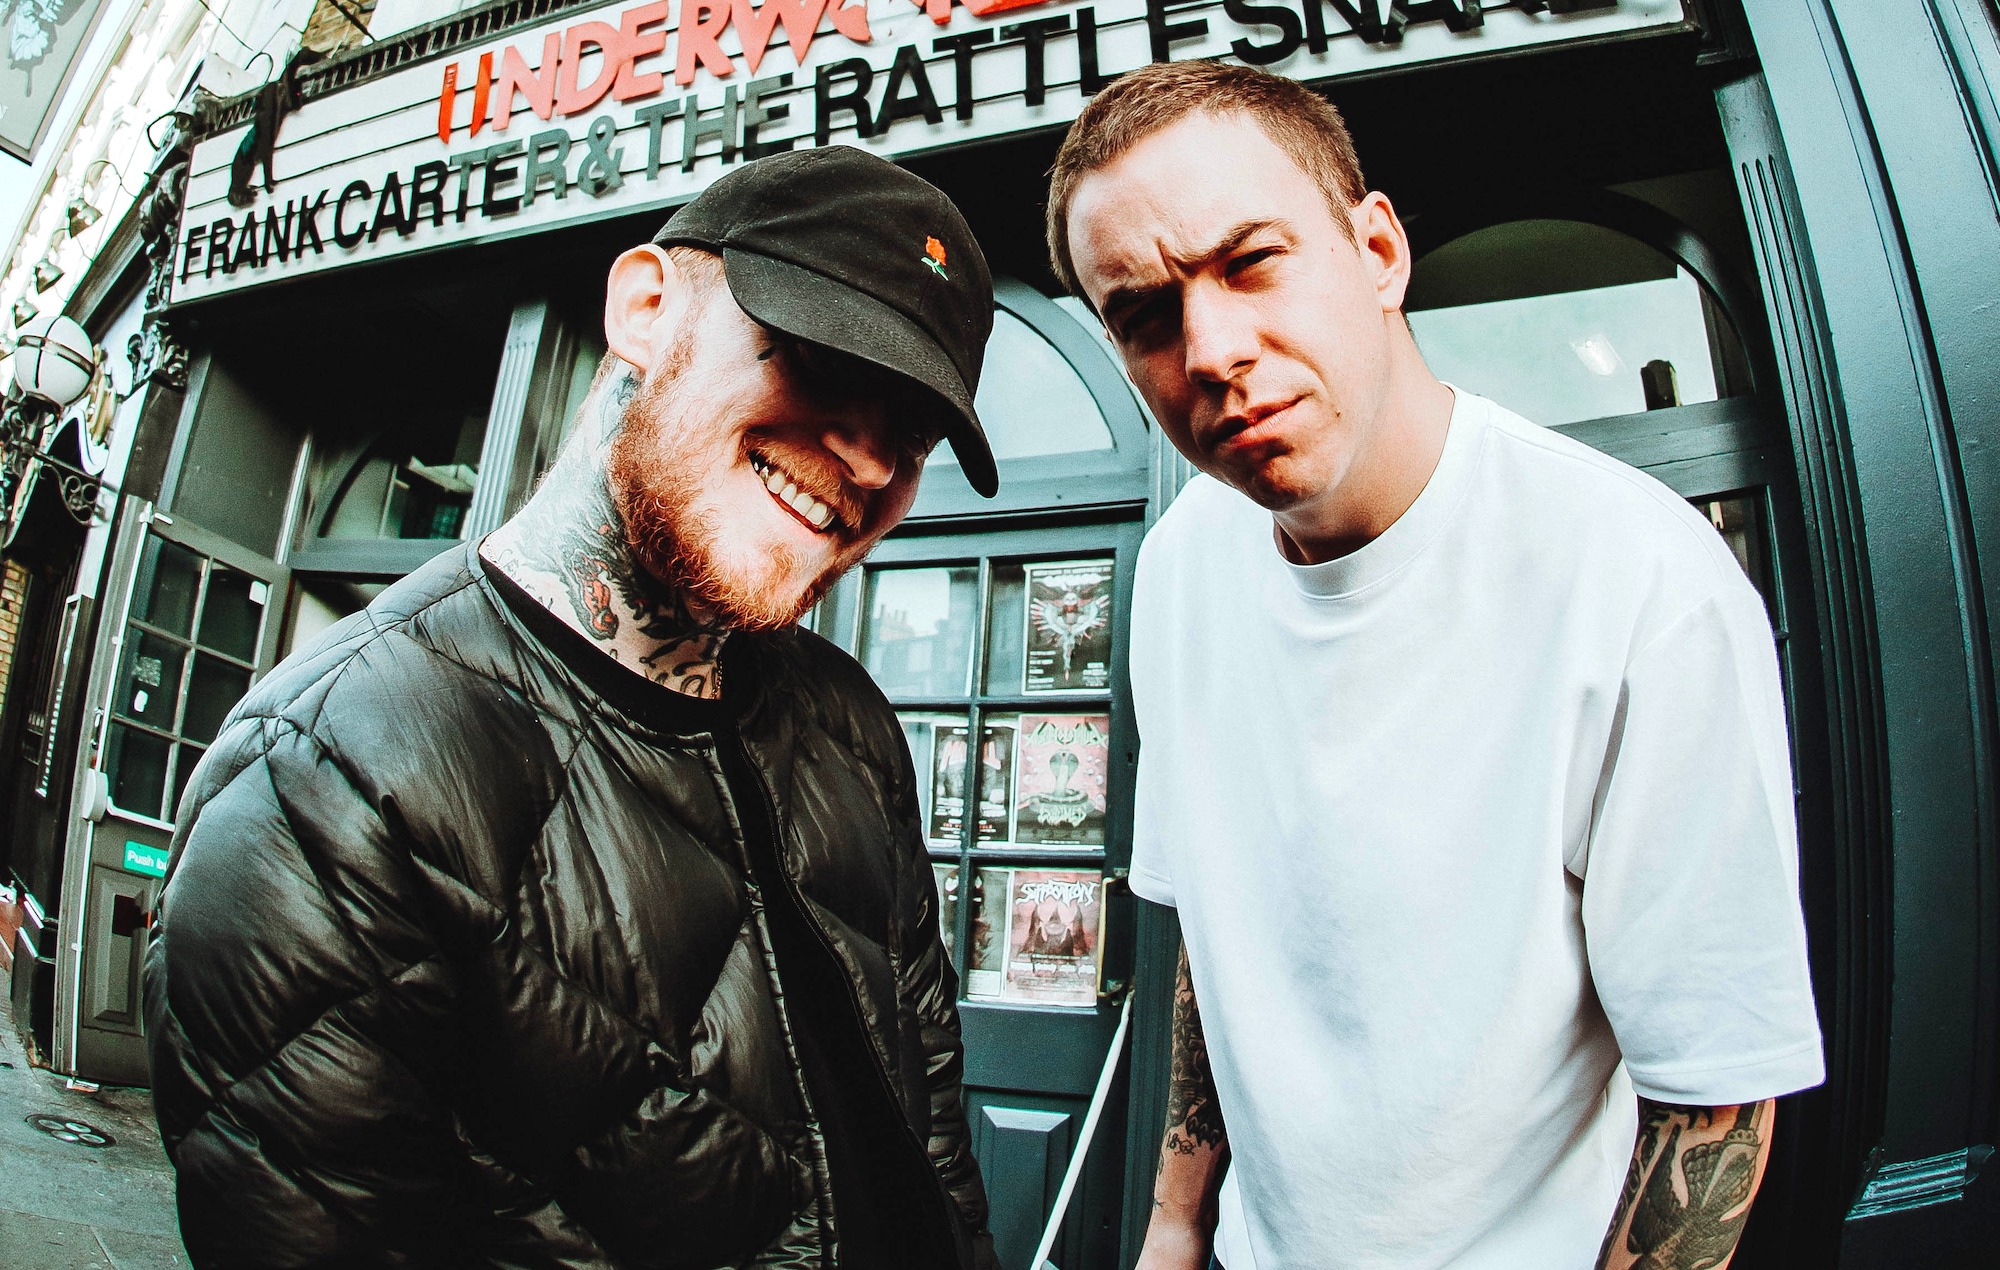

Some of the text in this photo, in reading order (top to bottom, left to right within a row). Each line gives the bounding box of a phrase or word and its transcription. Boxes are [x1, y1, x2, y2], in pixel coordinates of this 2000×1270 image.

[181, 0, 1617, 284] FRANK CARTER & THE RATTLESN
[438, 0, 1056, 144] UNDERW
[127, 849, 155, 868] Push
